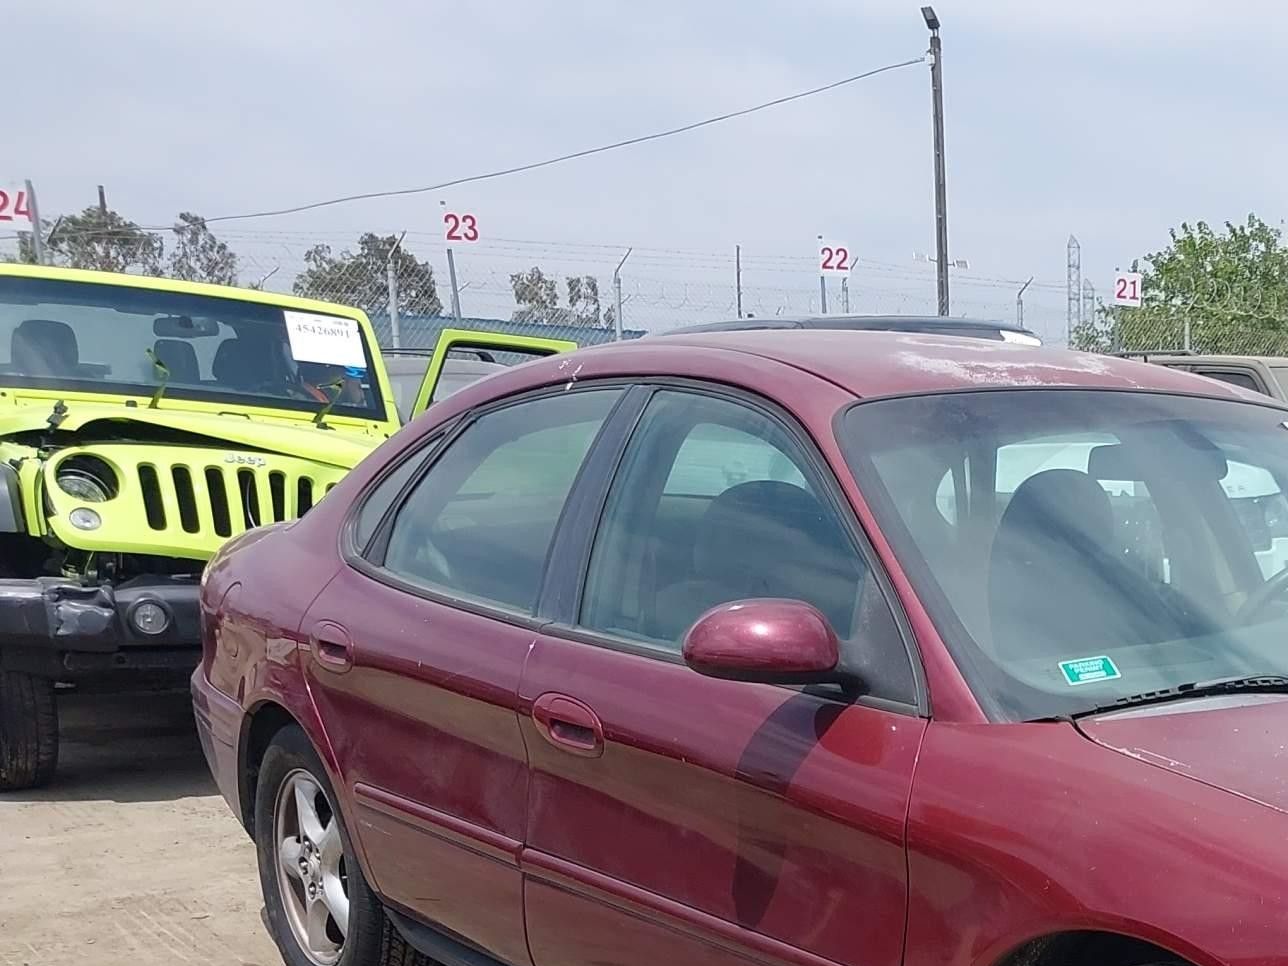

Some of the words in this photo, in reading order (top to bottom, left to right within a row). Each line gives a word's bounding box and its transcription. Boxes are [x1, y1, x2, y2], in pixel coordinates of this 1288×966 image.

[0, 190, 34, 222] 24
[444, 213, 479, 241] 23
[821, 247, 849, 270] 22
[1116, 278, 1139, 300] 21
[224, 453, 266, 468] Jeep
